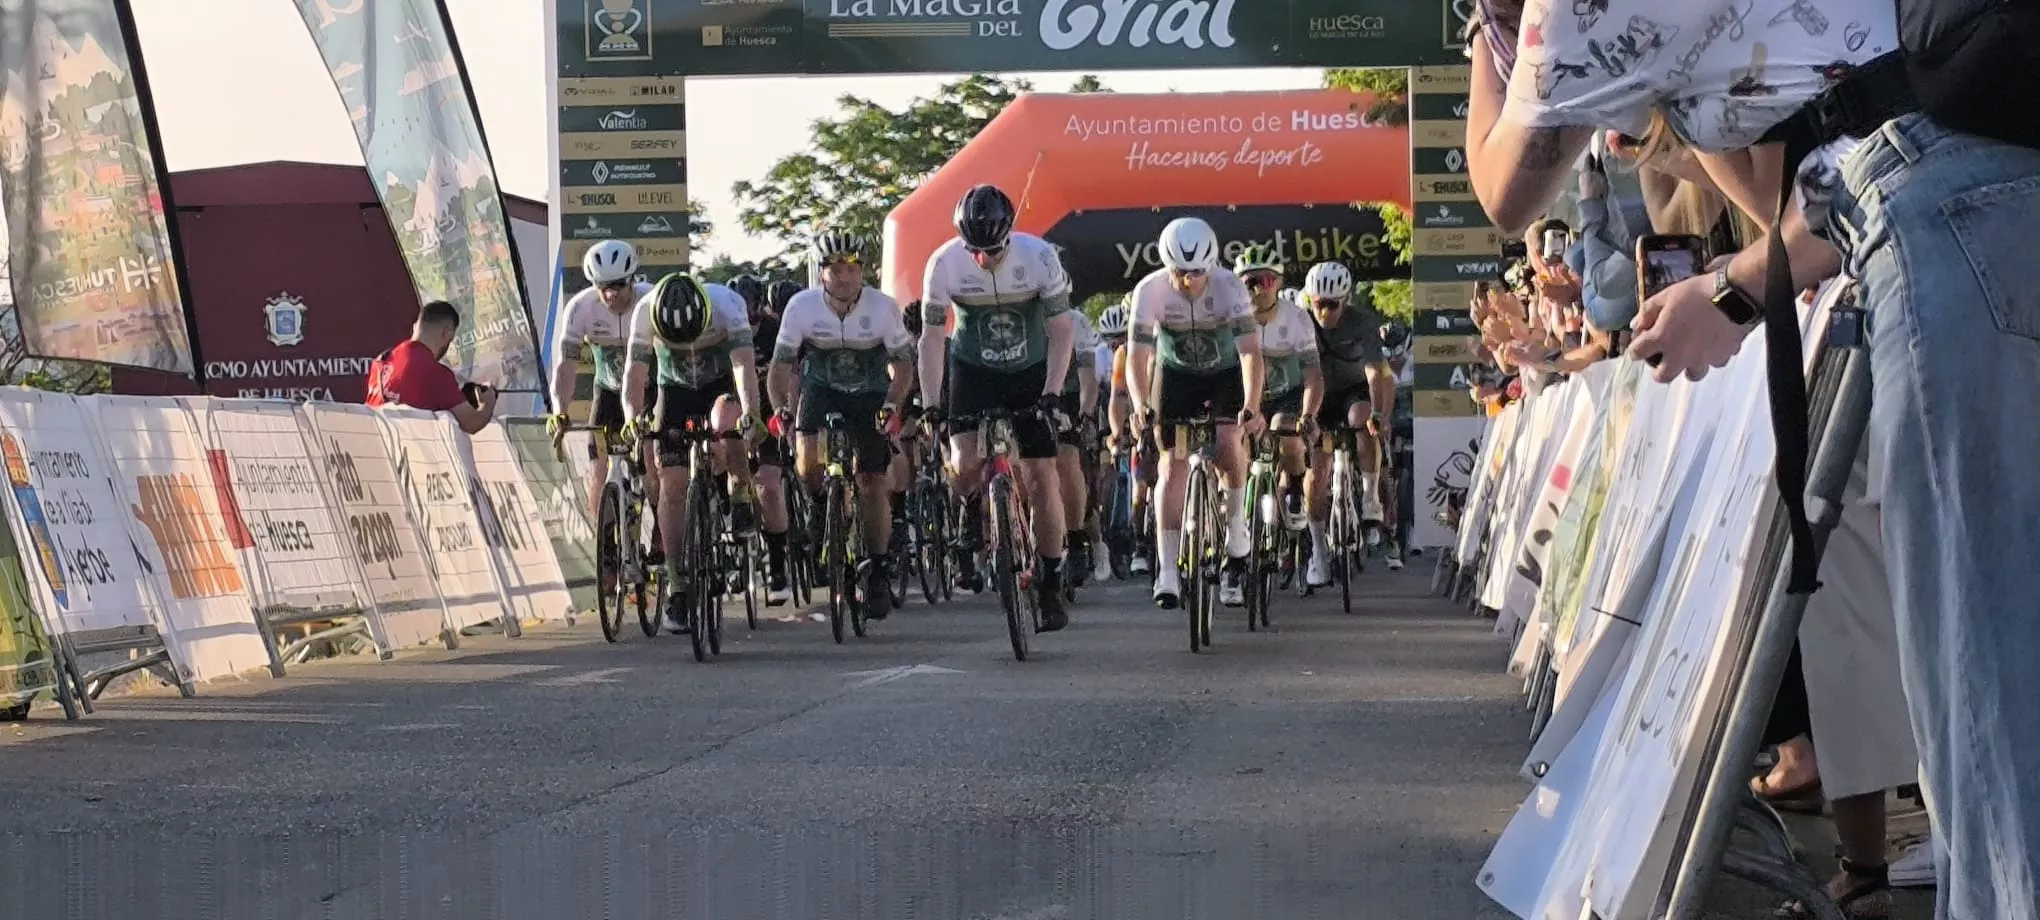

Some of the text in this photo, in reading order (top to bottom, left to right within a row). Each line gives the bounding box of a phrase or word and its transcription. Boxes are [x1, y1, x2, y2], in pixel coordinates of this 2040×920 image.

[740, 36, 776, 46] Huesca
[641, 85, 675, 96] MILAR
[598, 108, 648, 129] Valentia
[1064, 113, 1244, 141] Ayuntamiento
[1252, 111, 1281, 131] de
[1125, 138, 1324, 176] Hacemos deporte
[250, 358, 372, 378] AYUNTAMIENT
[328, 435, 364, 502] alto
[236, 462, 316, 501] Ayuntamiento
